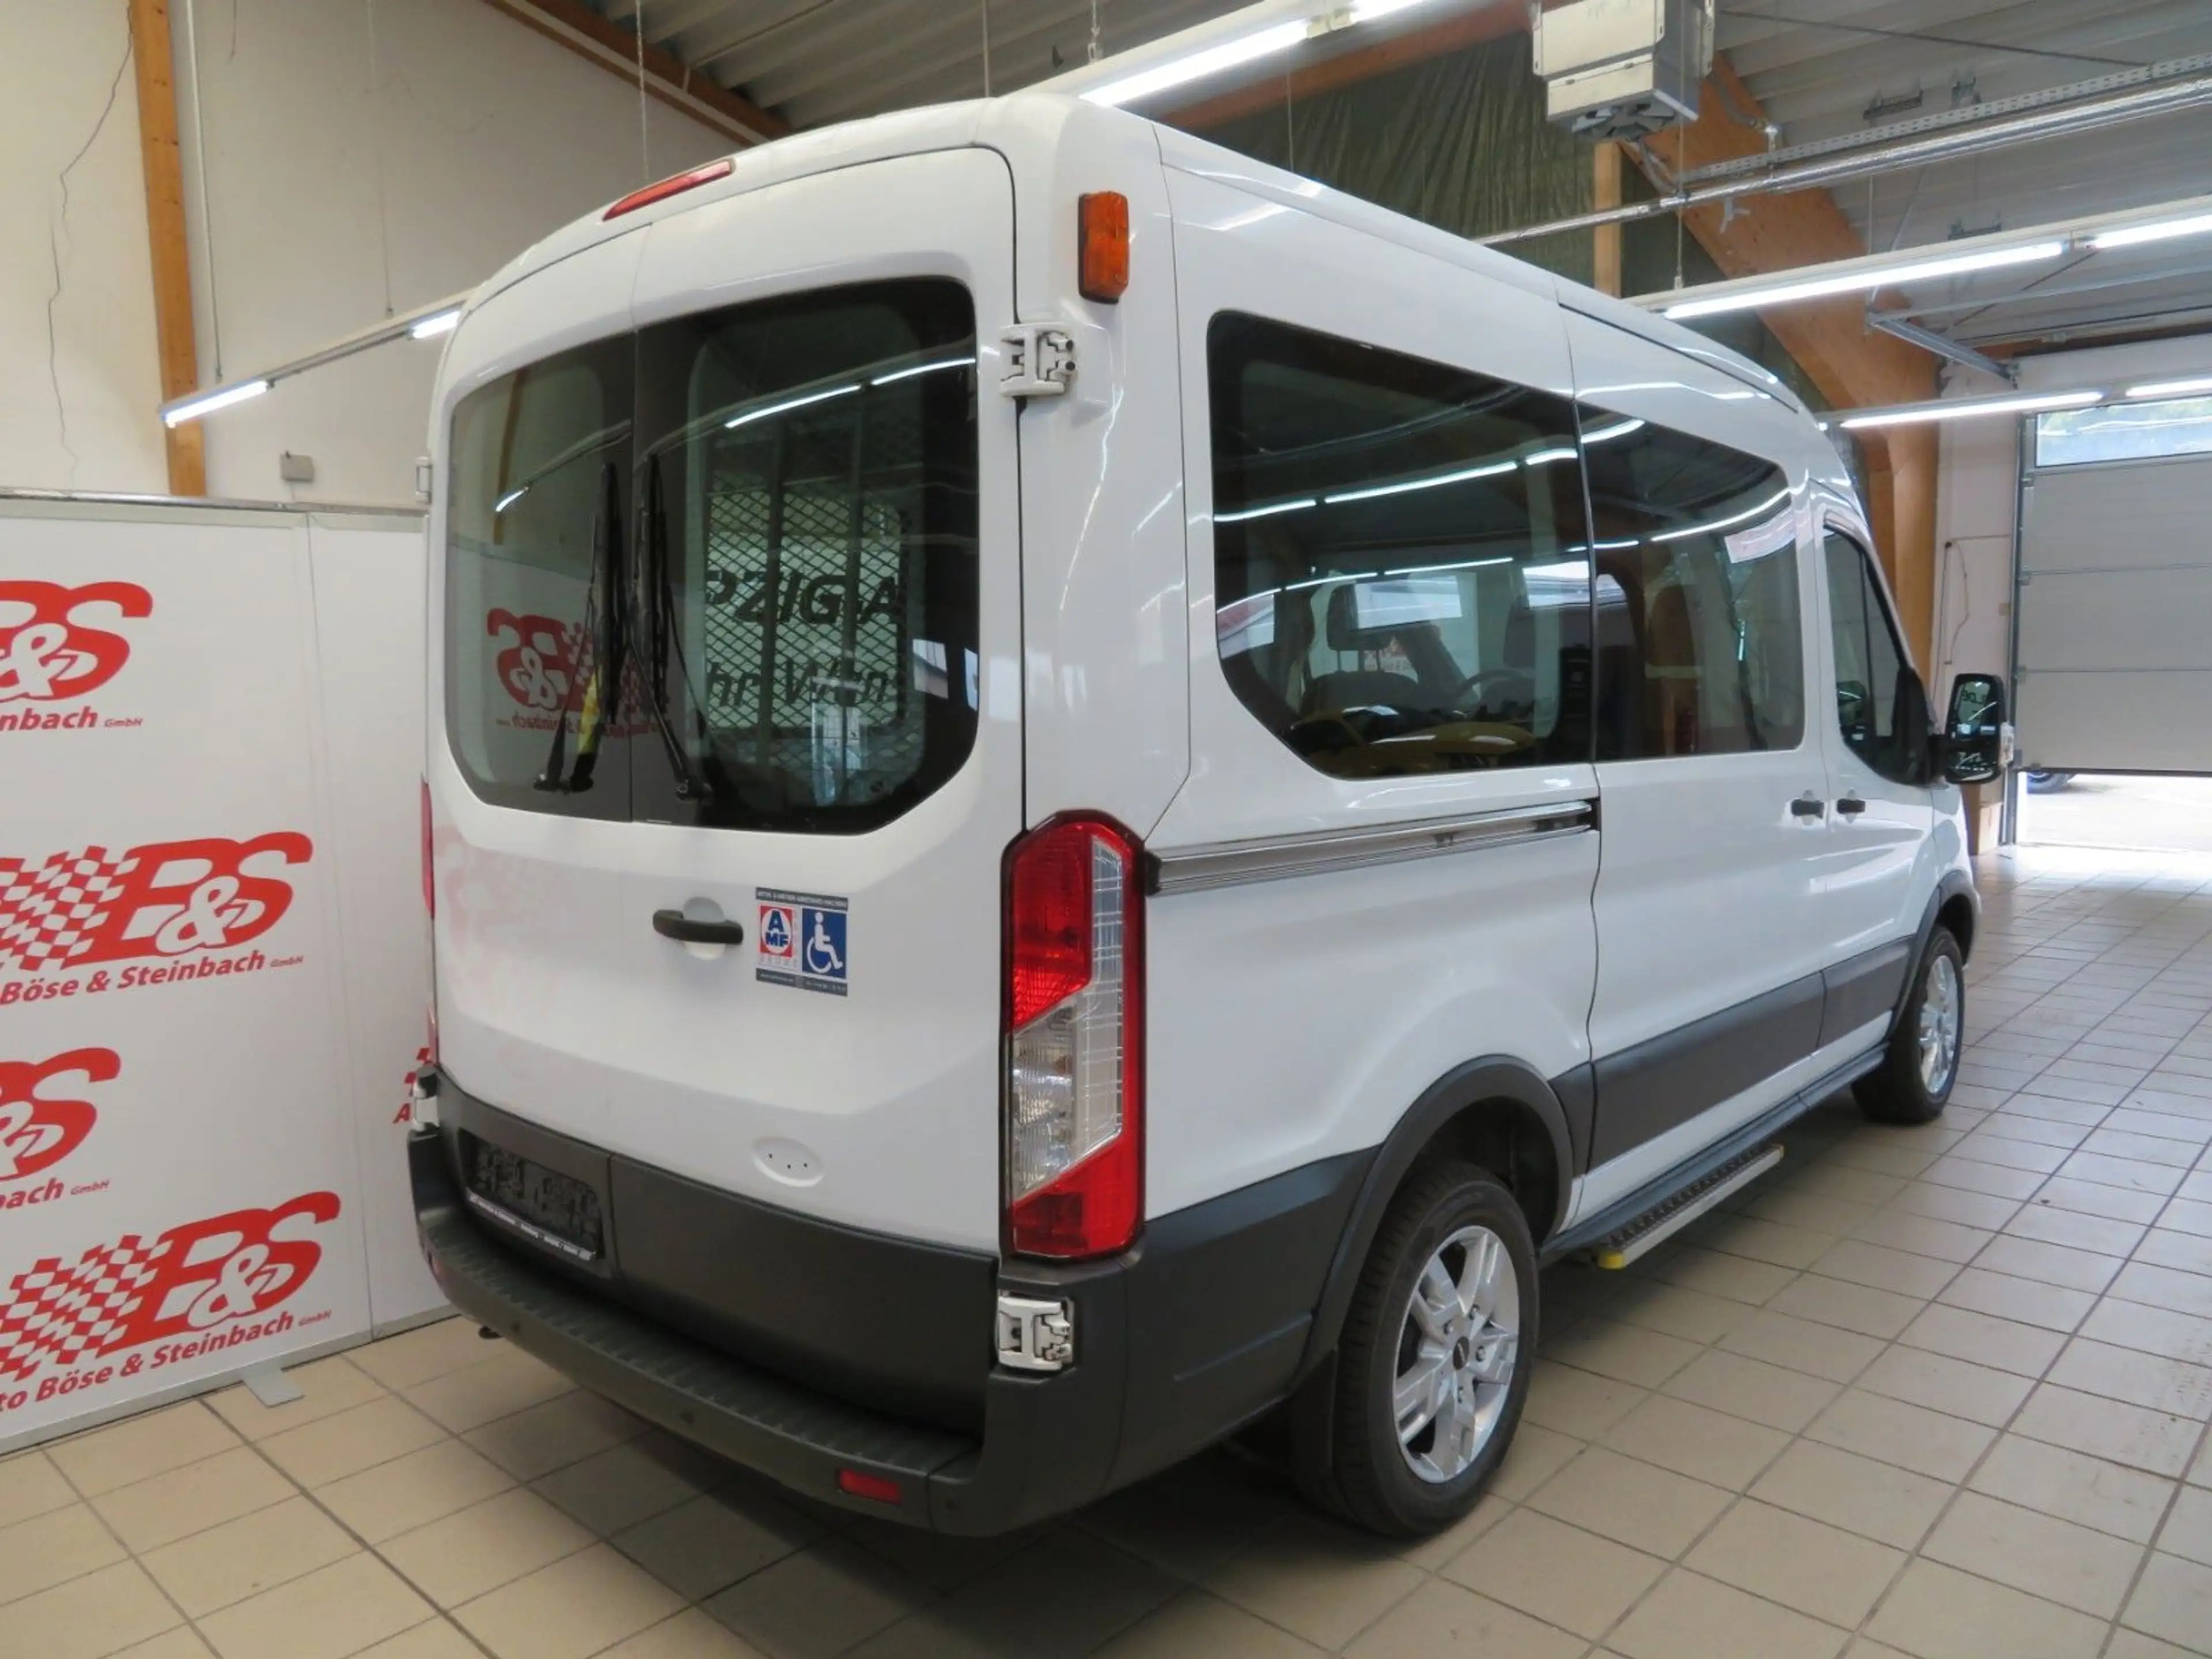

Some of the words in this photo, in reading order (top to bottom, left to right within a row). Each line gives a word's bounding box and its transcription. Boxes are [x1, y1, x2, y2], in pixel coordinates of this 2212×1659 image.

[0, 978, 80, 1005] Böse
[86, 969, 111, 993] &
[117, 950, 266, 990] Steinbach
[35, 1366, 113, 1403] Böse
[120, 1353, 143, 1377] &
[150, 1310, 294, 1370] Steinbach
